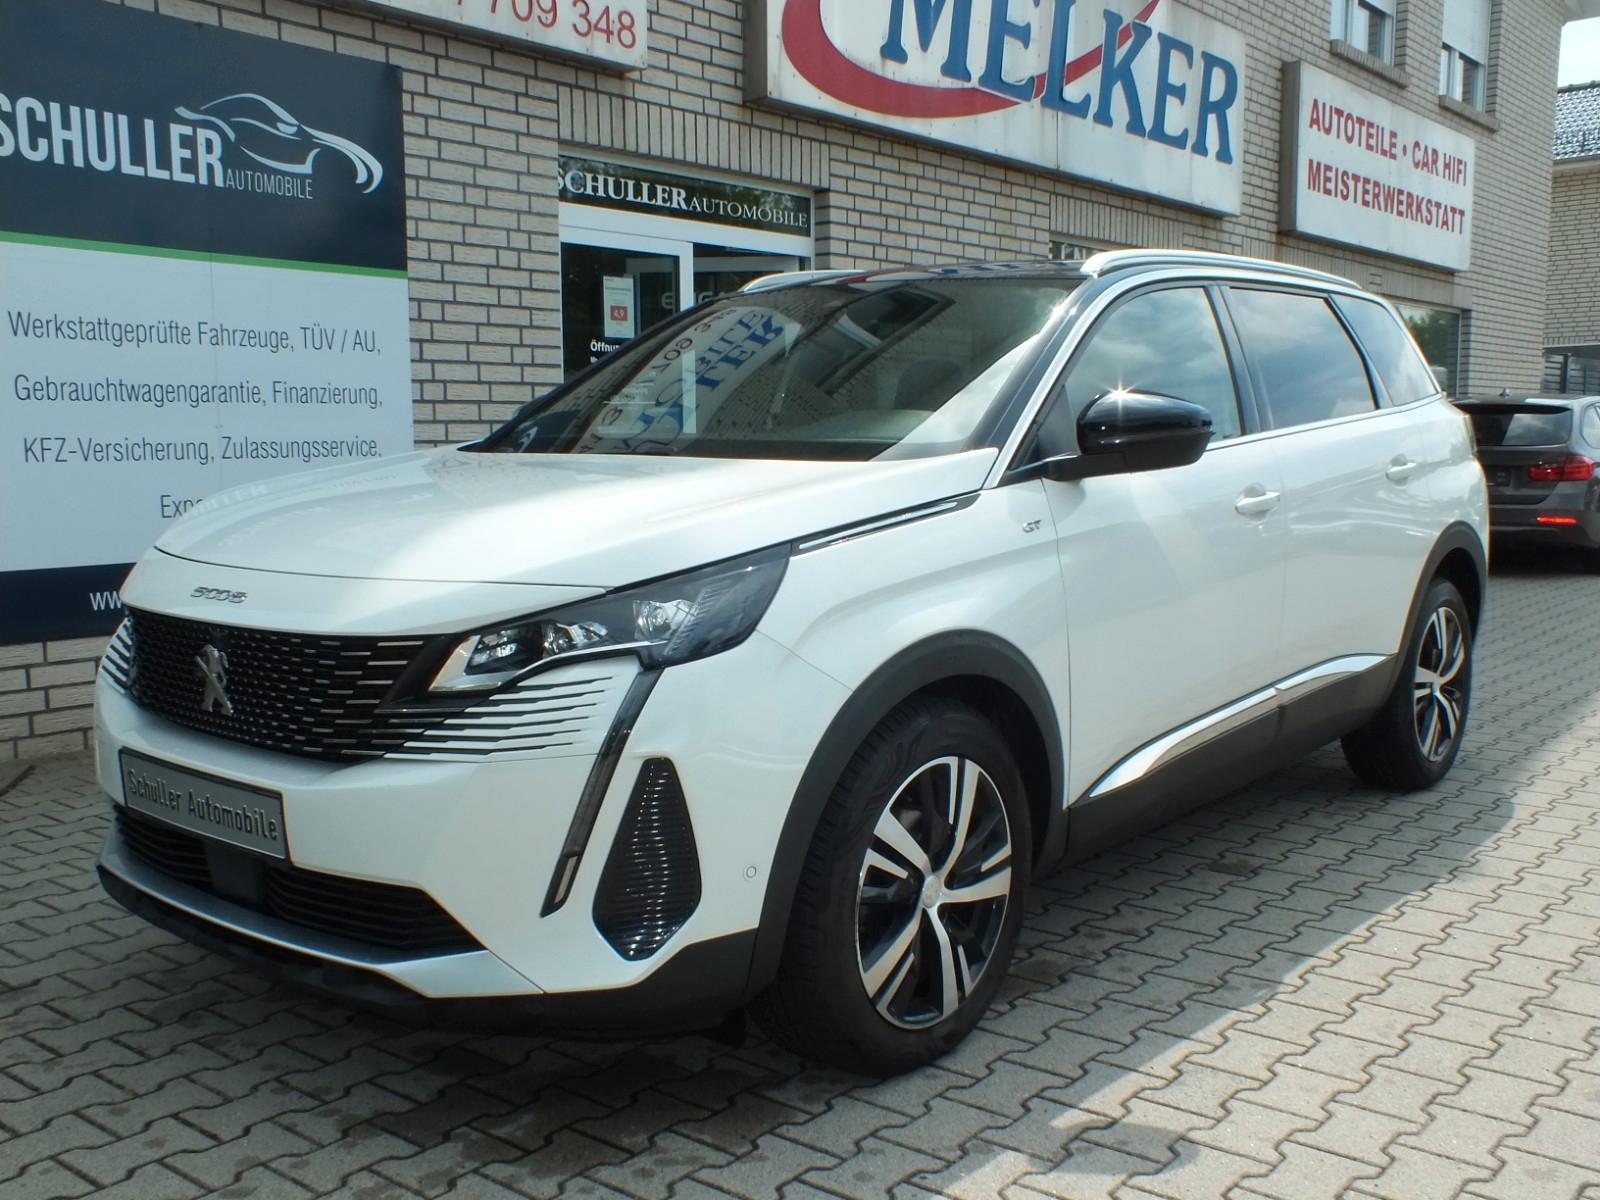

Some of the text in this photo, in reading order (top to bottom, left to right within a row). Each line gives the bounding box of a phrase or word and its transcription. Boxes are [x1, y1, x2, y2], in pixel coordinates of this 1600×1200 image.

[572, 0, 637, 49] 348
[880, 0, 1239, 165] MELKER
[1308, 98, 1468, 187] AUTOTEILE CAR HIFI
[225, 171, 313, 200] AUTOMOBILE
[1307, 158, 1466, 235] MEISTERWERKSTATT
[687, 195, 808, 228] AUTOMOBILE
[8, 310, 192, 349] Werkstattgeprüfte
[198, 321, 295, 354] Fahrzeuge,
[300, 323, 336, 351] TÜV
[352, 328, 381, 356] AU,
[14, 374, 383, 409] Gebrauchtwagengarantie, Finanzierung,
[23, 436, 216, 466] KFZ-Versicherung,
[1023, 519, 1042, 534] GT
[128, 768, 278, 841] Schuller Automobile
